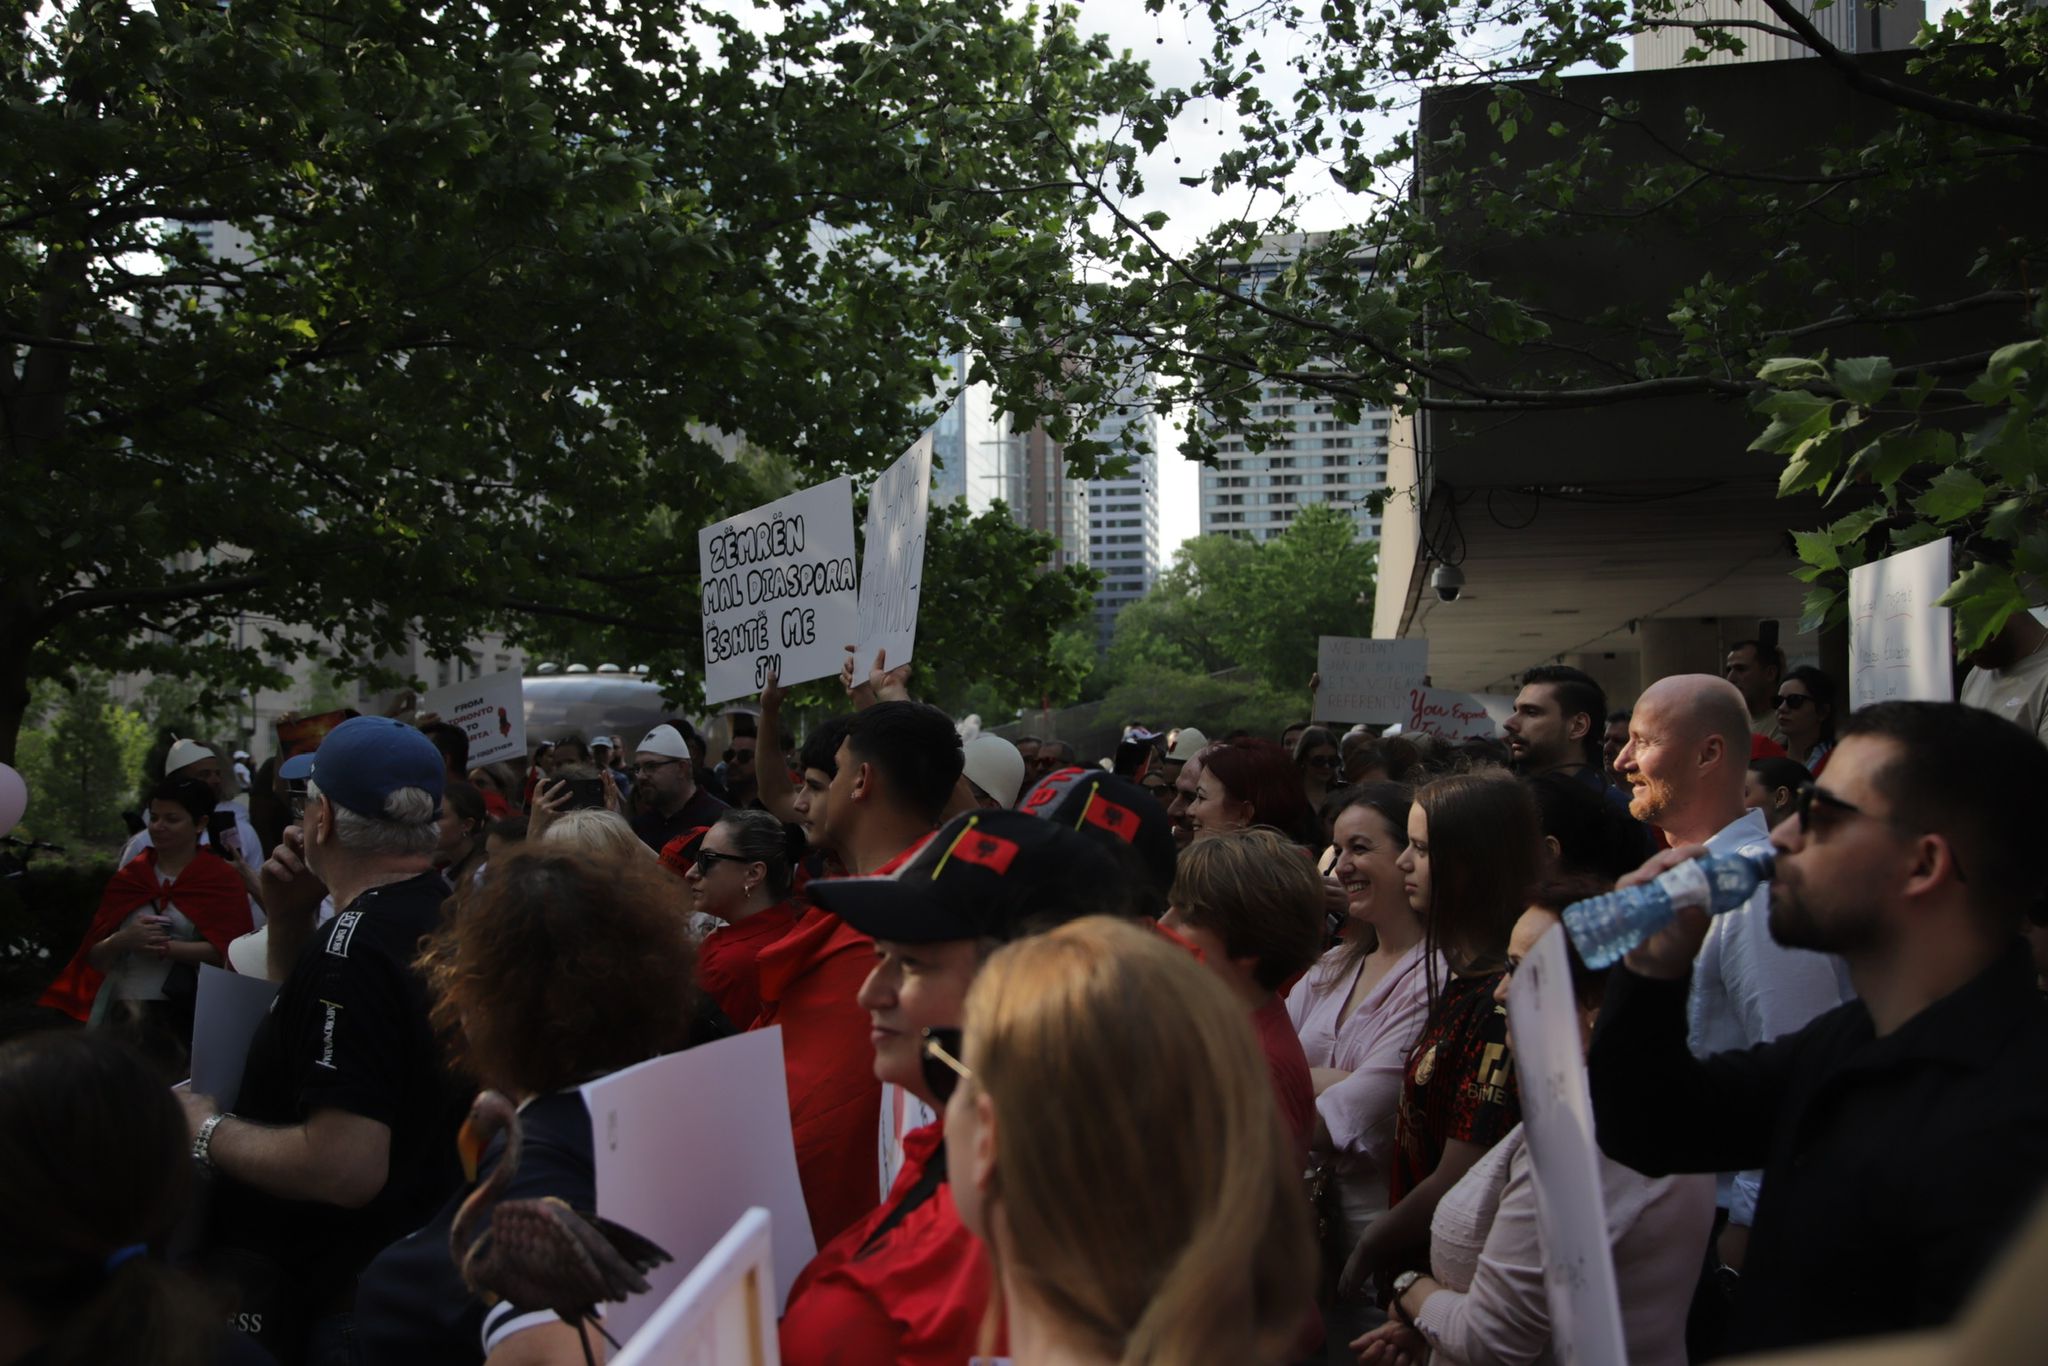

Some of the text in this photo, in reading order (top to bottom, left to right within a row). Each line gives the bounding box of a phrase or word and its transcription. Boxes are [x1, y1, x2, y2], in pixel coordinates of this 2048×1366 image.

[709, 511, 805, 574] ZËMRËN
[702, 573, 744, 616] MAL
[746, 557, 856, 605] DIASPORA
[705, 607, 816, 664] ËSHTË ME
[1327, 640, 1351, 655] WE
[447, 706, 494, 726] TORONTO
[454, 697, 484, 714] FROM
[1409, 688, 1449, 730] You
[466, 722, 479, 732] TO
